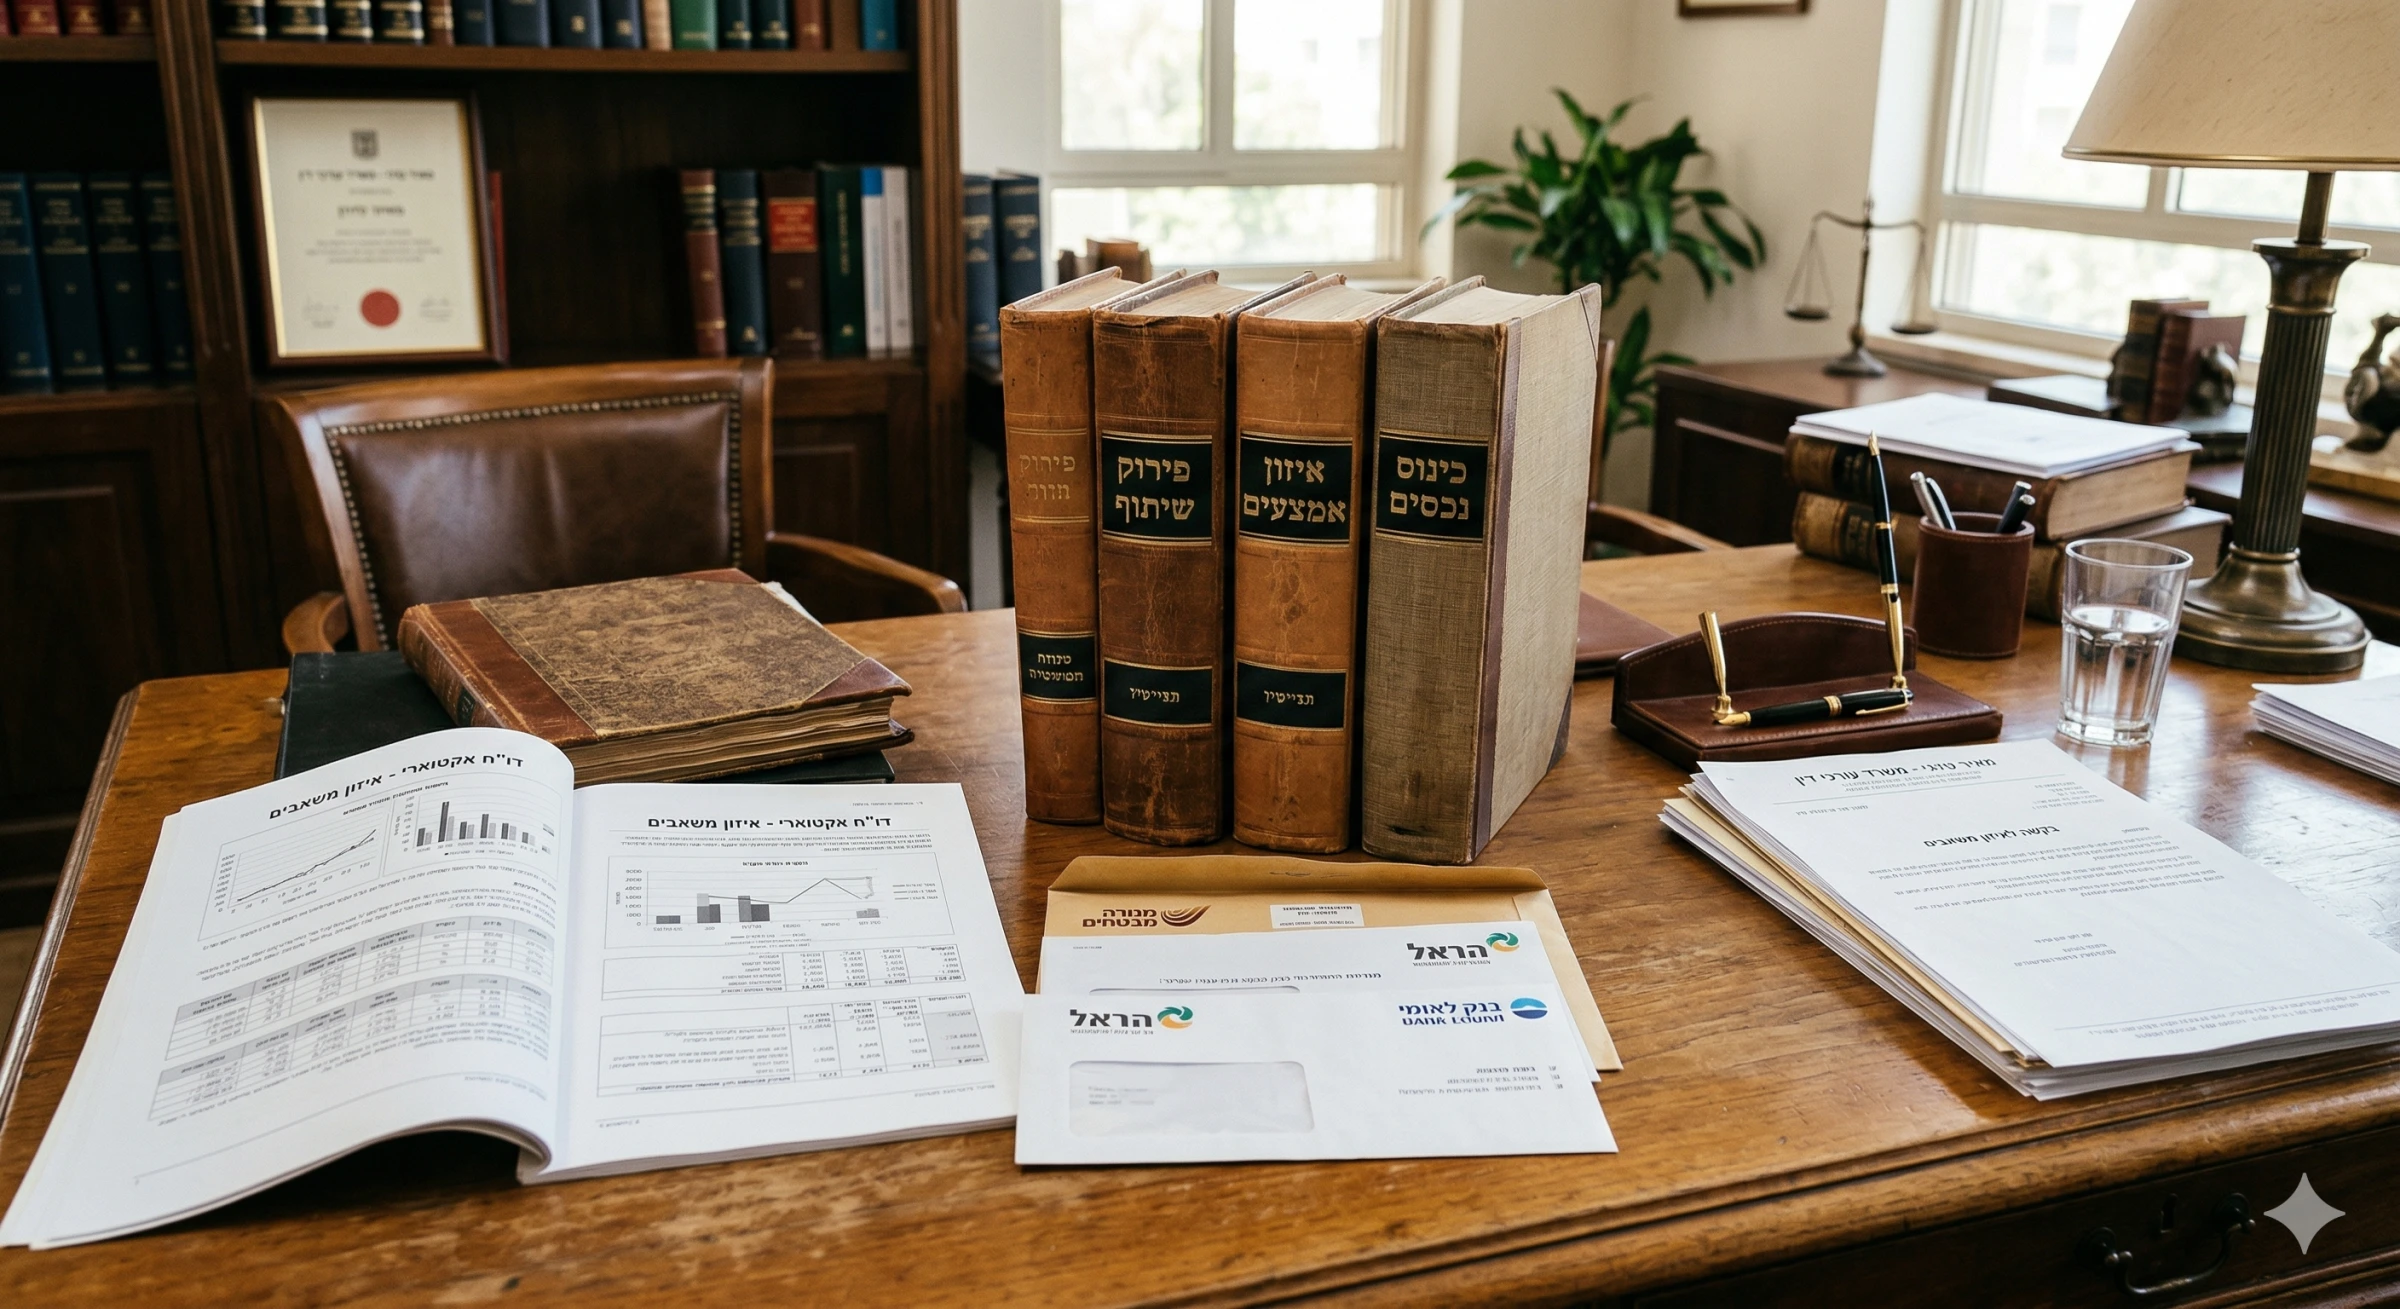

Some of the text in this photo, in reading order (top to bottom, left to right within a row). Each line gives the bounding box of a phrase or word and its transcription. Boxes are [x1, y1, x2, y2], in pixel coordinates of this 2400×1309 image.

[1118, 456, 1191, 485] פירוק
[1264, 456, 1325, 486] איזון
[1397, 455, 1467, 484] כינוס
[1115, 494, 1195, 523] שיתוף
[1243, 493, 1346, 523] אמצעים
[1390, 491, 1469, 520] נכסים
[402, 755, 475, 774] אקטוארי
[482, 753, 523, 768] דו"ח
[1957, 758, 1997, 768] מאיר
[1819, 770, 1859, 782] עורכי
[1861, 766, 1909, 777] משרד
[344, 775, 382, 798] איזון
[1794, 775, 1817, 787] דין
[269, 789, 338, 819] משאבים
[648, 818, 717, 829] משאבים
[724, 819, 761, 831] איזון
[779, 818, 848, 831] אקטוארי
[853, 815, 891, 828] דו"ח
[2018, 825, 2060, 836] בקשה
[1103, 909, 1157, 917] מנורה
[1082, 918, 1158, 928] מבטחים
[1406, 943, 1489, 960] הראל
[1398, 1001, 1502, 1017] בנק לאומי
[1070, 1009, 1152, 1028] הראל
